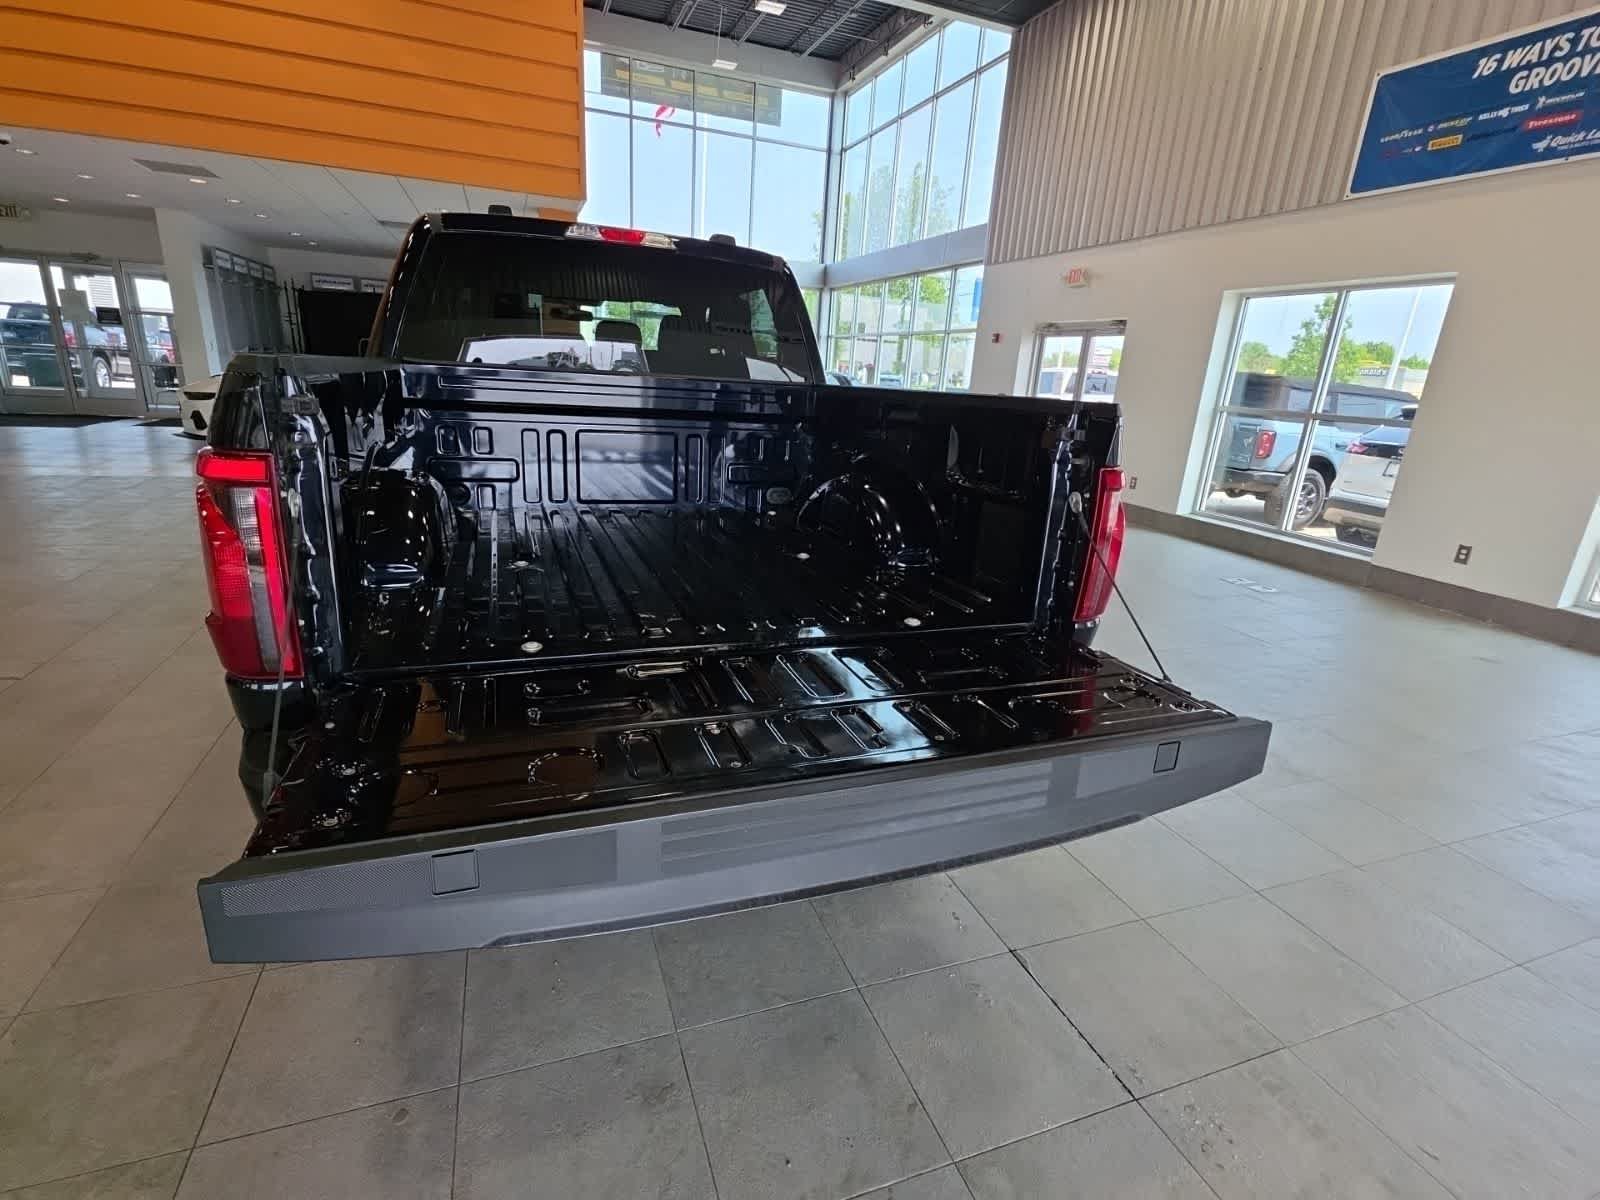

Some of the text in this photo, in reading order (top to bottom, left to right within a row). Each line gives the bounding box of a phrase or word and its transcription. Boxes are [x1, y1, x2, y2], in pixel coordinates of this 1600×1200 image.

[1472, 53, 1503, 79] 16
[1501, 32, 1576, 71] WAYS
[1550, 130, 1586, 147] Quick
